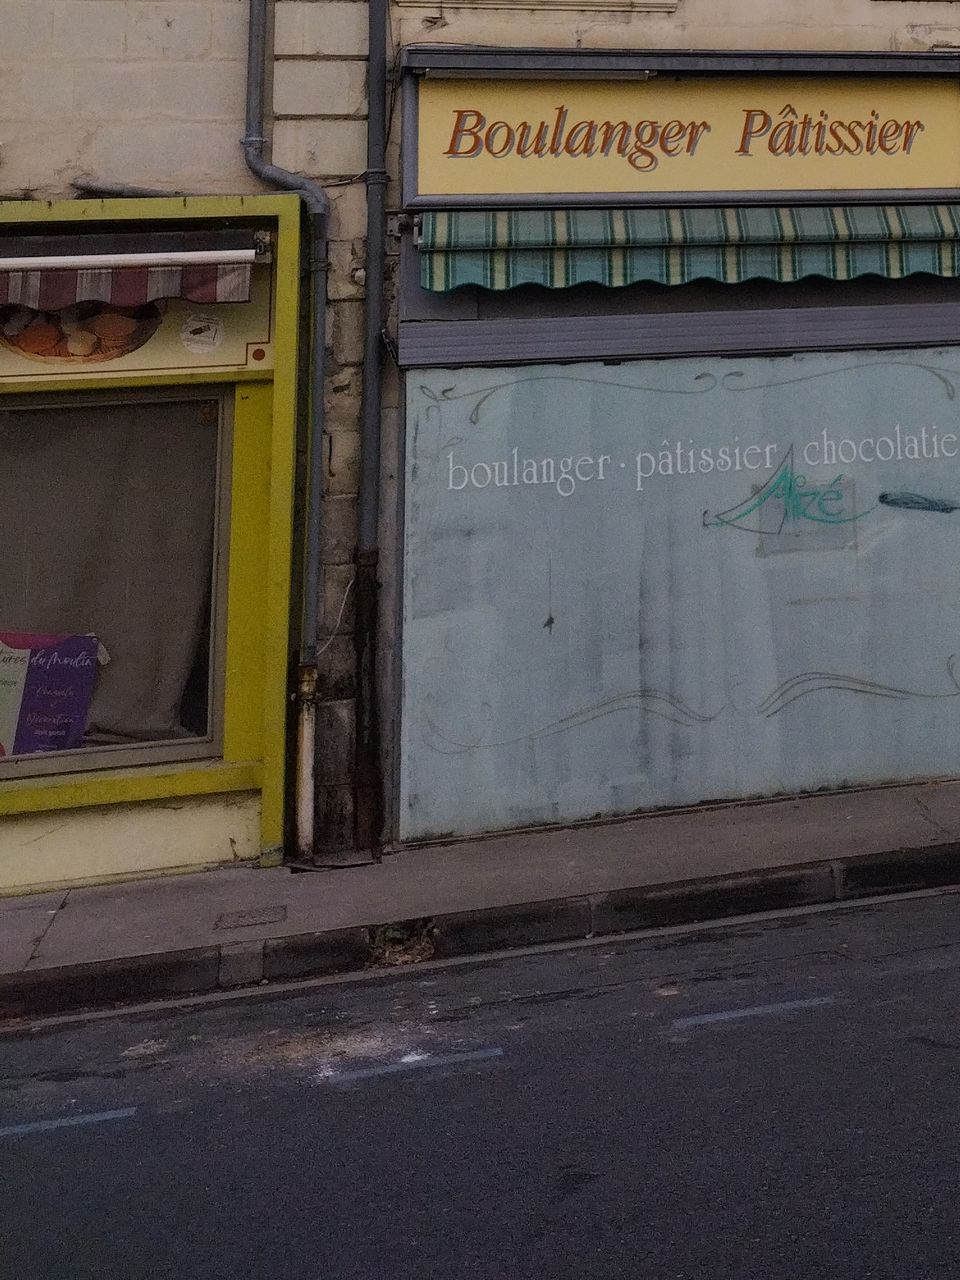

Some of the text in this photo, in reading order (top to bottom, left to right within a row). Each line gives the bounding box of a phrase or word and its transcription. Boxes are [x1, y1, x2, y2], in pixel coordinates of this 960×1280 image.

[443, 103, 925, 172] Boulanger Pâtissier
[446, 446, 612, 497] boulanger
[635, 436, 777, 491] pâtissier
